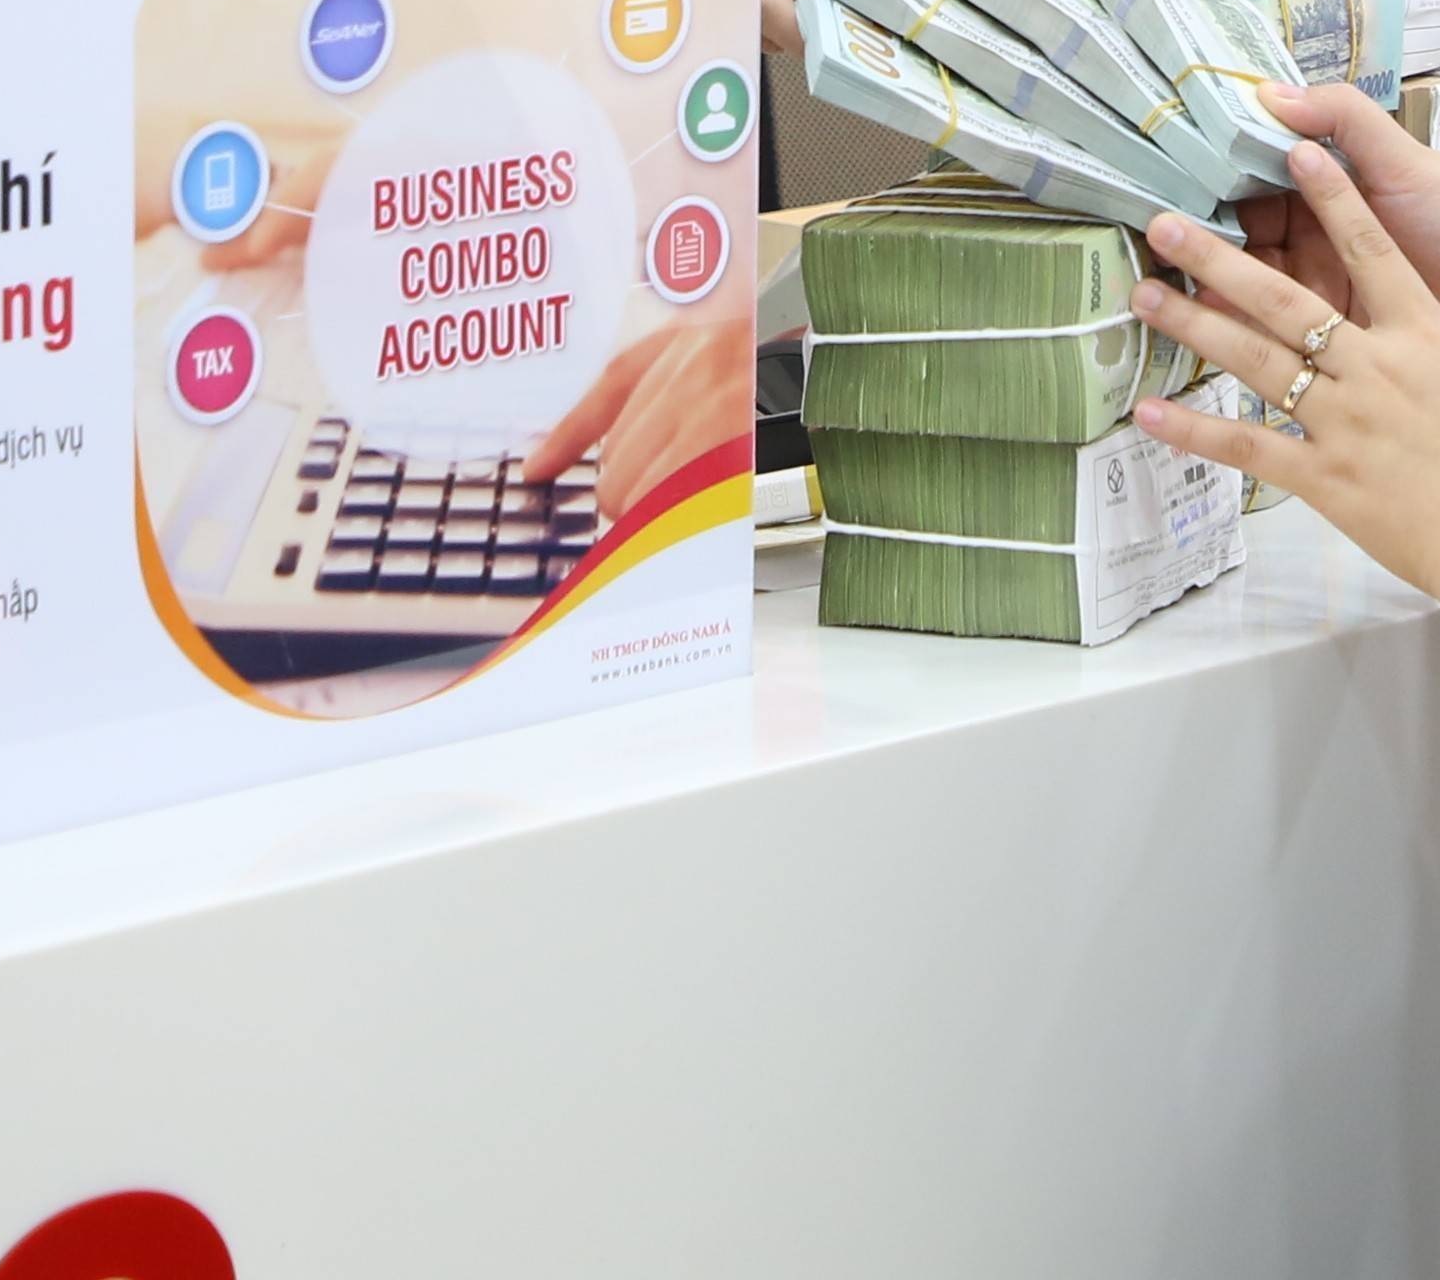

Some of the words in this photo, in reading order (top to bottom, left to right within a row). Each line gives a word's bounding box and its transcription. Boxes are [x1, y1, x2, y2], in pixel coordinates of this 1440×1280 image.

[372, 149, 576, 233] BUSINESS
[400, 225, 549, 301] COMBO
[376, 293, 572, 379] ACCOUNT
[193, 345, 234, 380] TAX
[55, 424, 84, 458] vụ
[591, 647, 610, 663] NH
[613, 638, 650, 659] TMCP
[652, 630, 689, 649] ĐÔNG
[691, 622, 720, 640] NAM
[591, 643, 732, 683] www.seabank.com.vn
